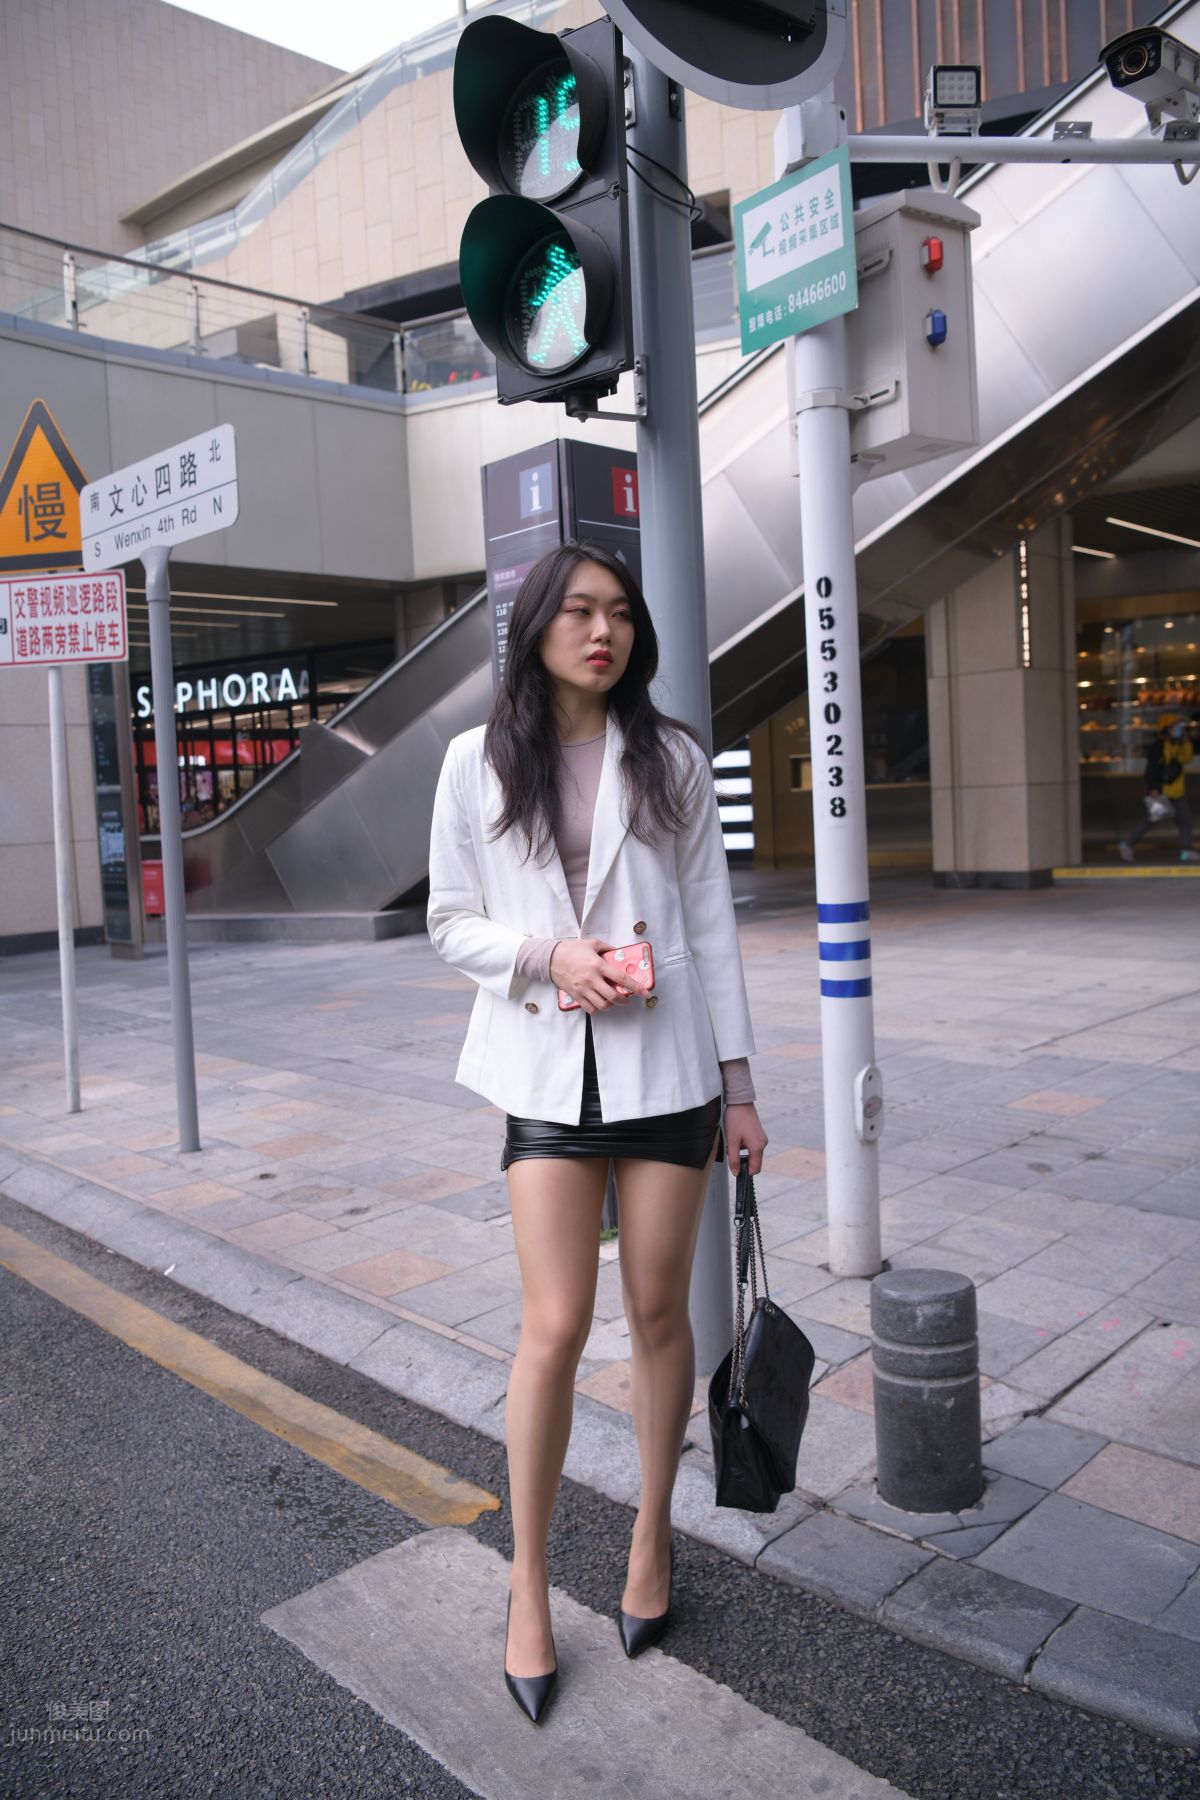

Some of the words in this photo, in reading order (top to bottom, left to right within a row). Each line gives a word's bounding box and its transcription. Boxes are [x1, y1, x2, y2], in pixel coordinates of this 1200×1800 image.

[780, 187, 835, 232] 公共安全
[778, 212, 840, 257] 视频采集区域
[787, 270, 847, 314] 84466600
[90, 492, 100, 513] 南
[108, 451, 198, 518] 文心四路
[208, 438, 222, 465] 北
[17, 481, 68, 543] 慢
[94, 543, 102, 559] S
[113, 524, 151, 550] Wenxin
[156, 515, 175, 534] 4th
[181, 505, 198, 527] Rd
[212, 494, 223, 516] N
[14, 581, 119, 619] 交警视频巡逻路段
[16, 620, 120, 657] 道路两旁禁止停车
[136, 667, 298, 718] SPHORA
